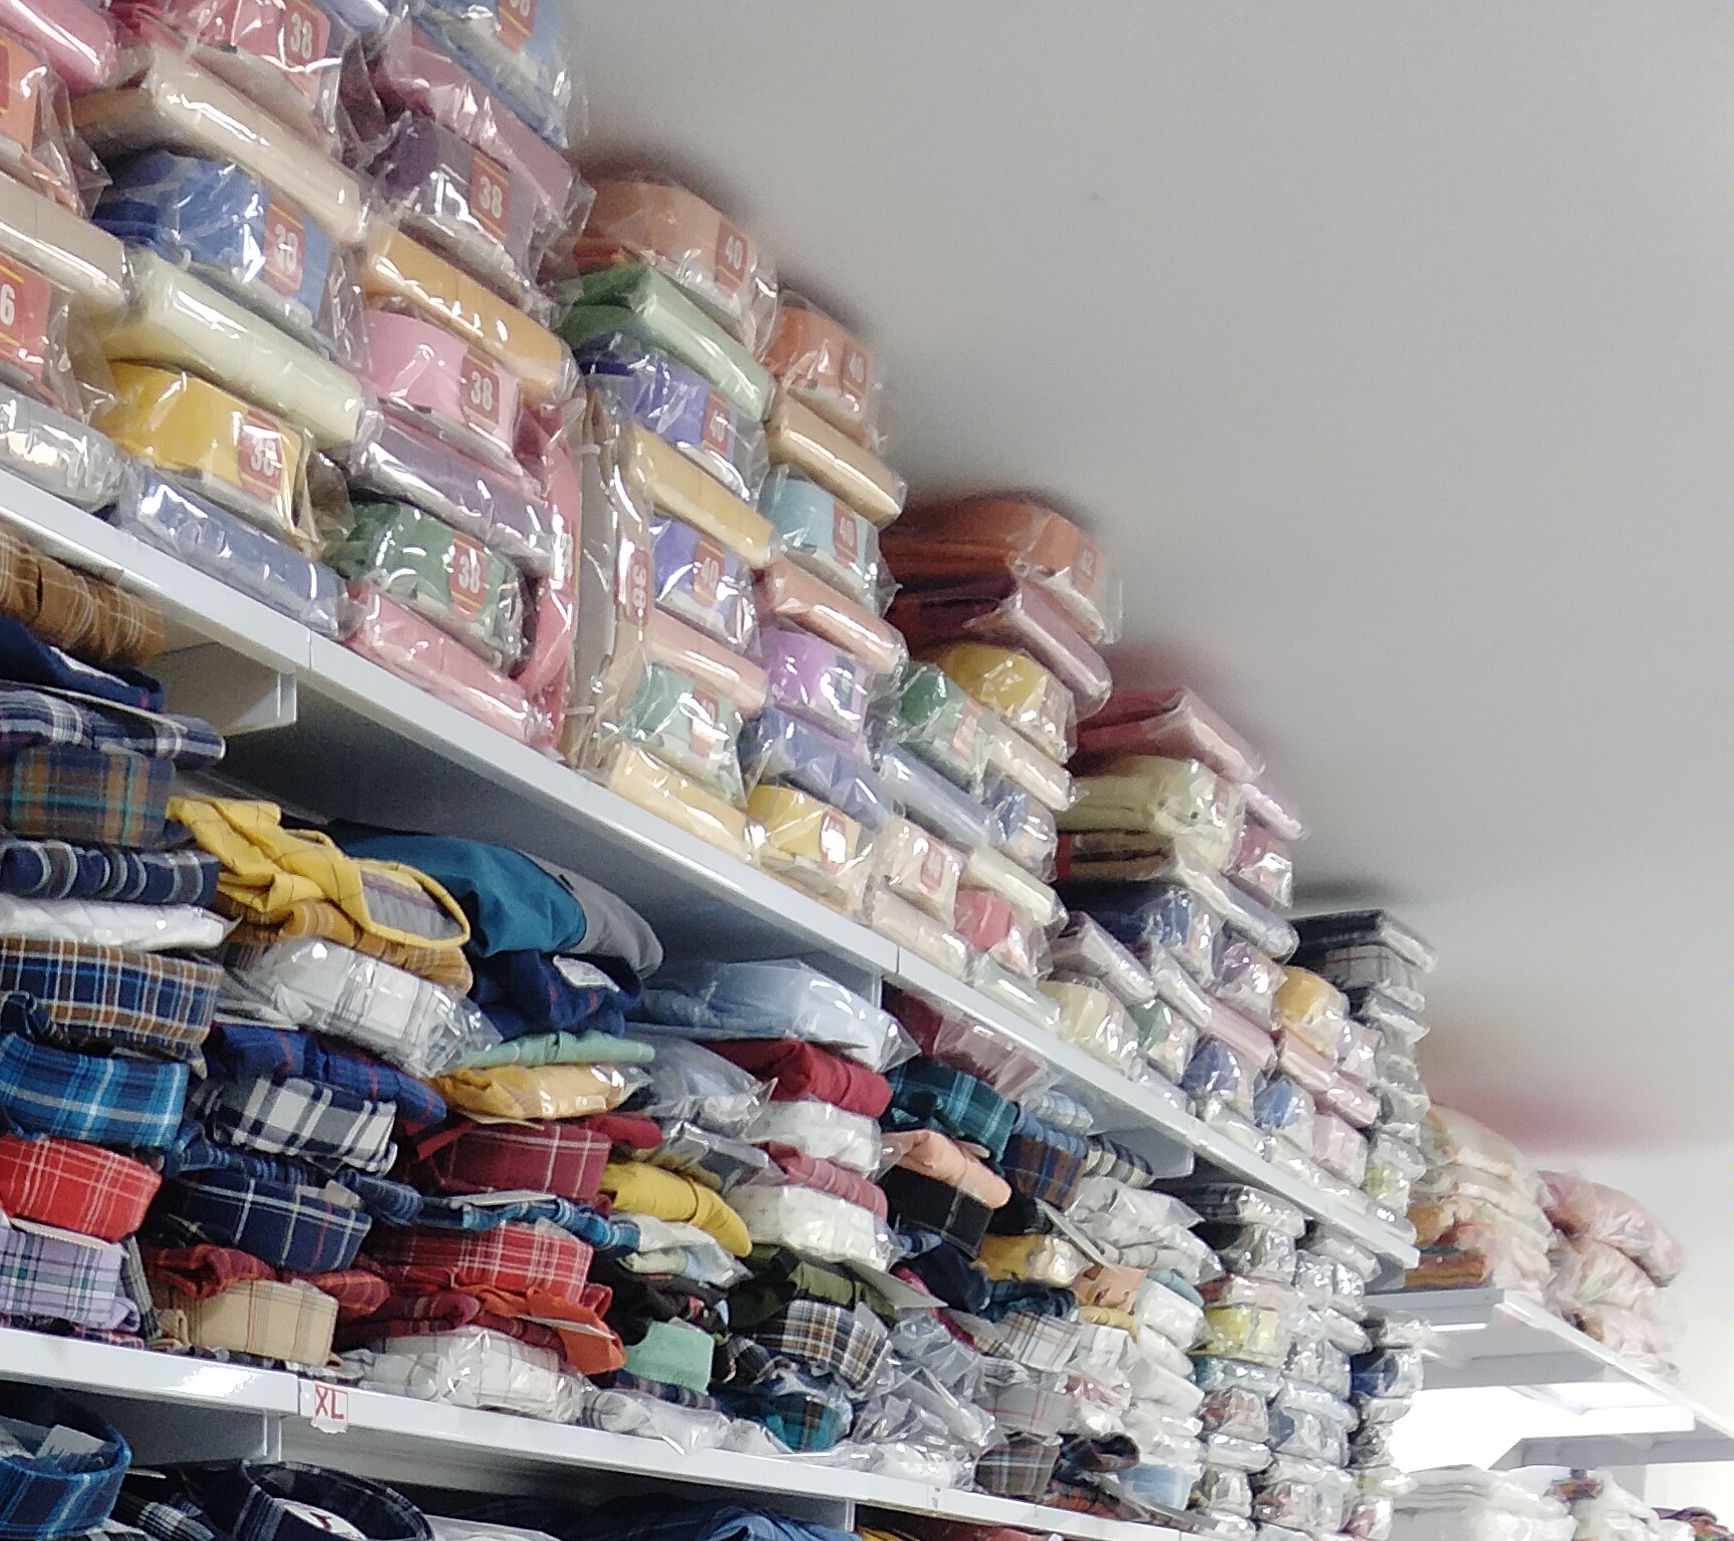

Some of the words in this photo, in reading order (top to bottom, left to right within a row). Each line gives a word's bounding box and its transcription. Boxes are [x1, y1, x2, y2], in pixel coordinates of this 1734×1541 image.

[290, 13, 313, 59] 38
[480, 177, 503, 219] 38
[471, 371, 492, 411] 38
[458, 554, 480, 593] 38
[315, 1386, 344, 1419] XL
